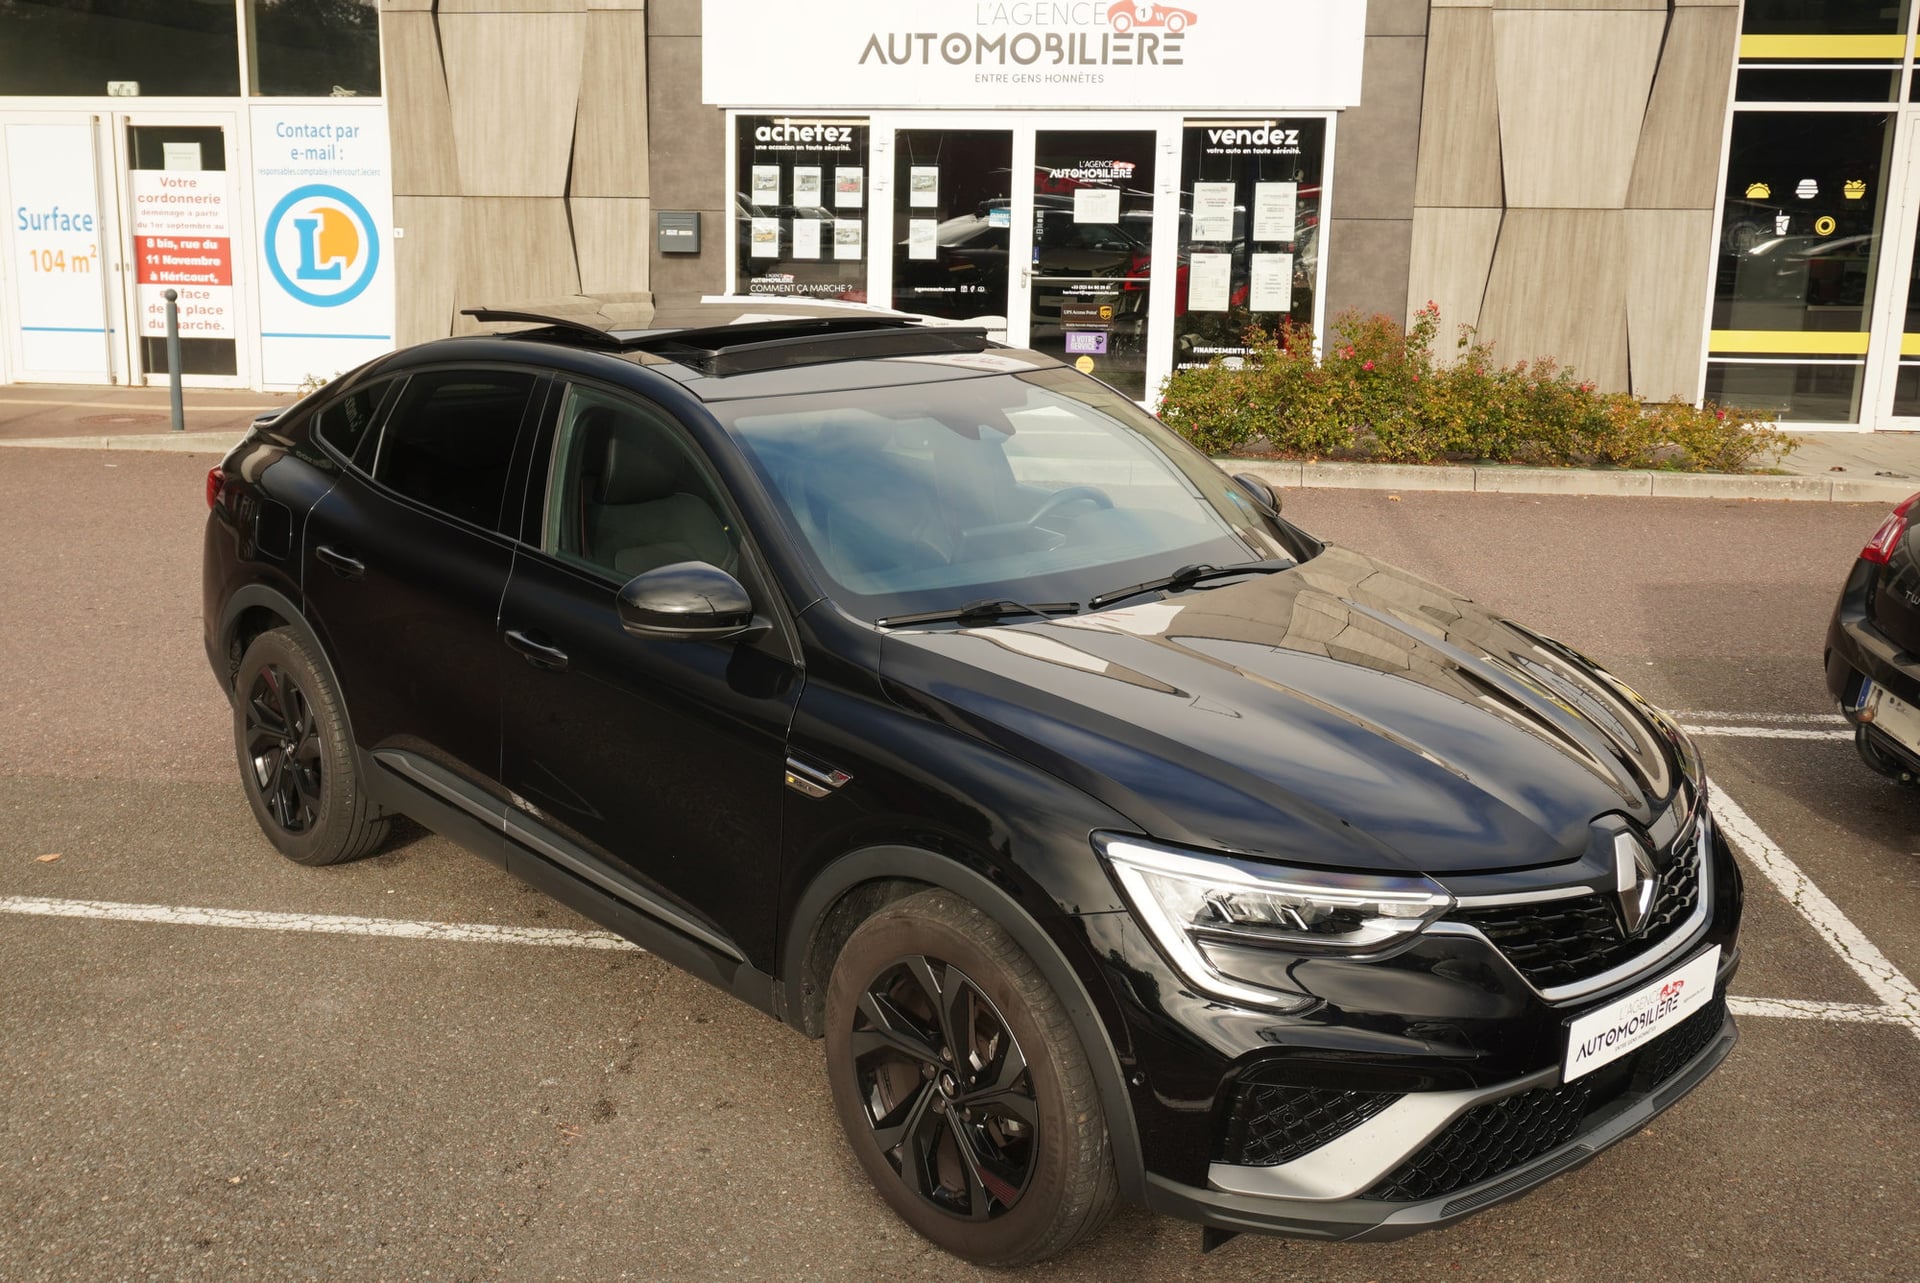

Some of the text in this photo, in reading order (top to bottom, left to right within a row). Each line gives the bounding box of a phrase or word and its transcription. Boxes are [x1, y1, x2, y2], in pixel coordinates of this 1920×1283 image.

[975, 2, 1108, 26] L'AGENCE
[974, 71, 1104, 84] ENTRE GENS HONNÊTES
[276, 121, 360, 142] Contact par
[755, 117, 852, 142] achetez
[1207, 120, 1299, 145] vendez
[290, 143, 336, 160] e-mail
[768, 143, 795, 151] occasion
[1079, 160, 1113, 168] L'AGENCE
[159, 177, 197, 188] Votre
[137, 193, 221, 204] cordonnerie
[17, 205, 93, 232] Surface
[166, 222, 212, 230] septembre
[146, 238, 218, 250] 8 bis, rue du
[29, 248, 66, 273] 104
[146, 254, 221, 266] 11 Novembre
[149, 271, 219, 284] à Héricourt,
[180, 288, 210, 299] face
[750, 284, 796, 293] COMMENT
[796, 284, 809, 294] ÇA
[809, 284, 846, 293] MARCHE
[148, 304, 164, 313] de
[186, 304, 224, 316] place
[148, 320, 164, 329] du
[1192, 346, 1246, 355] FINANCEMENTS
